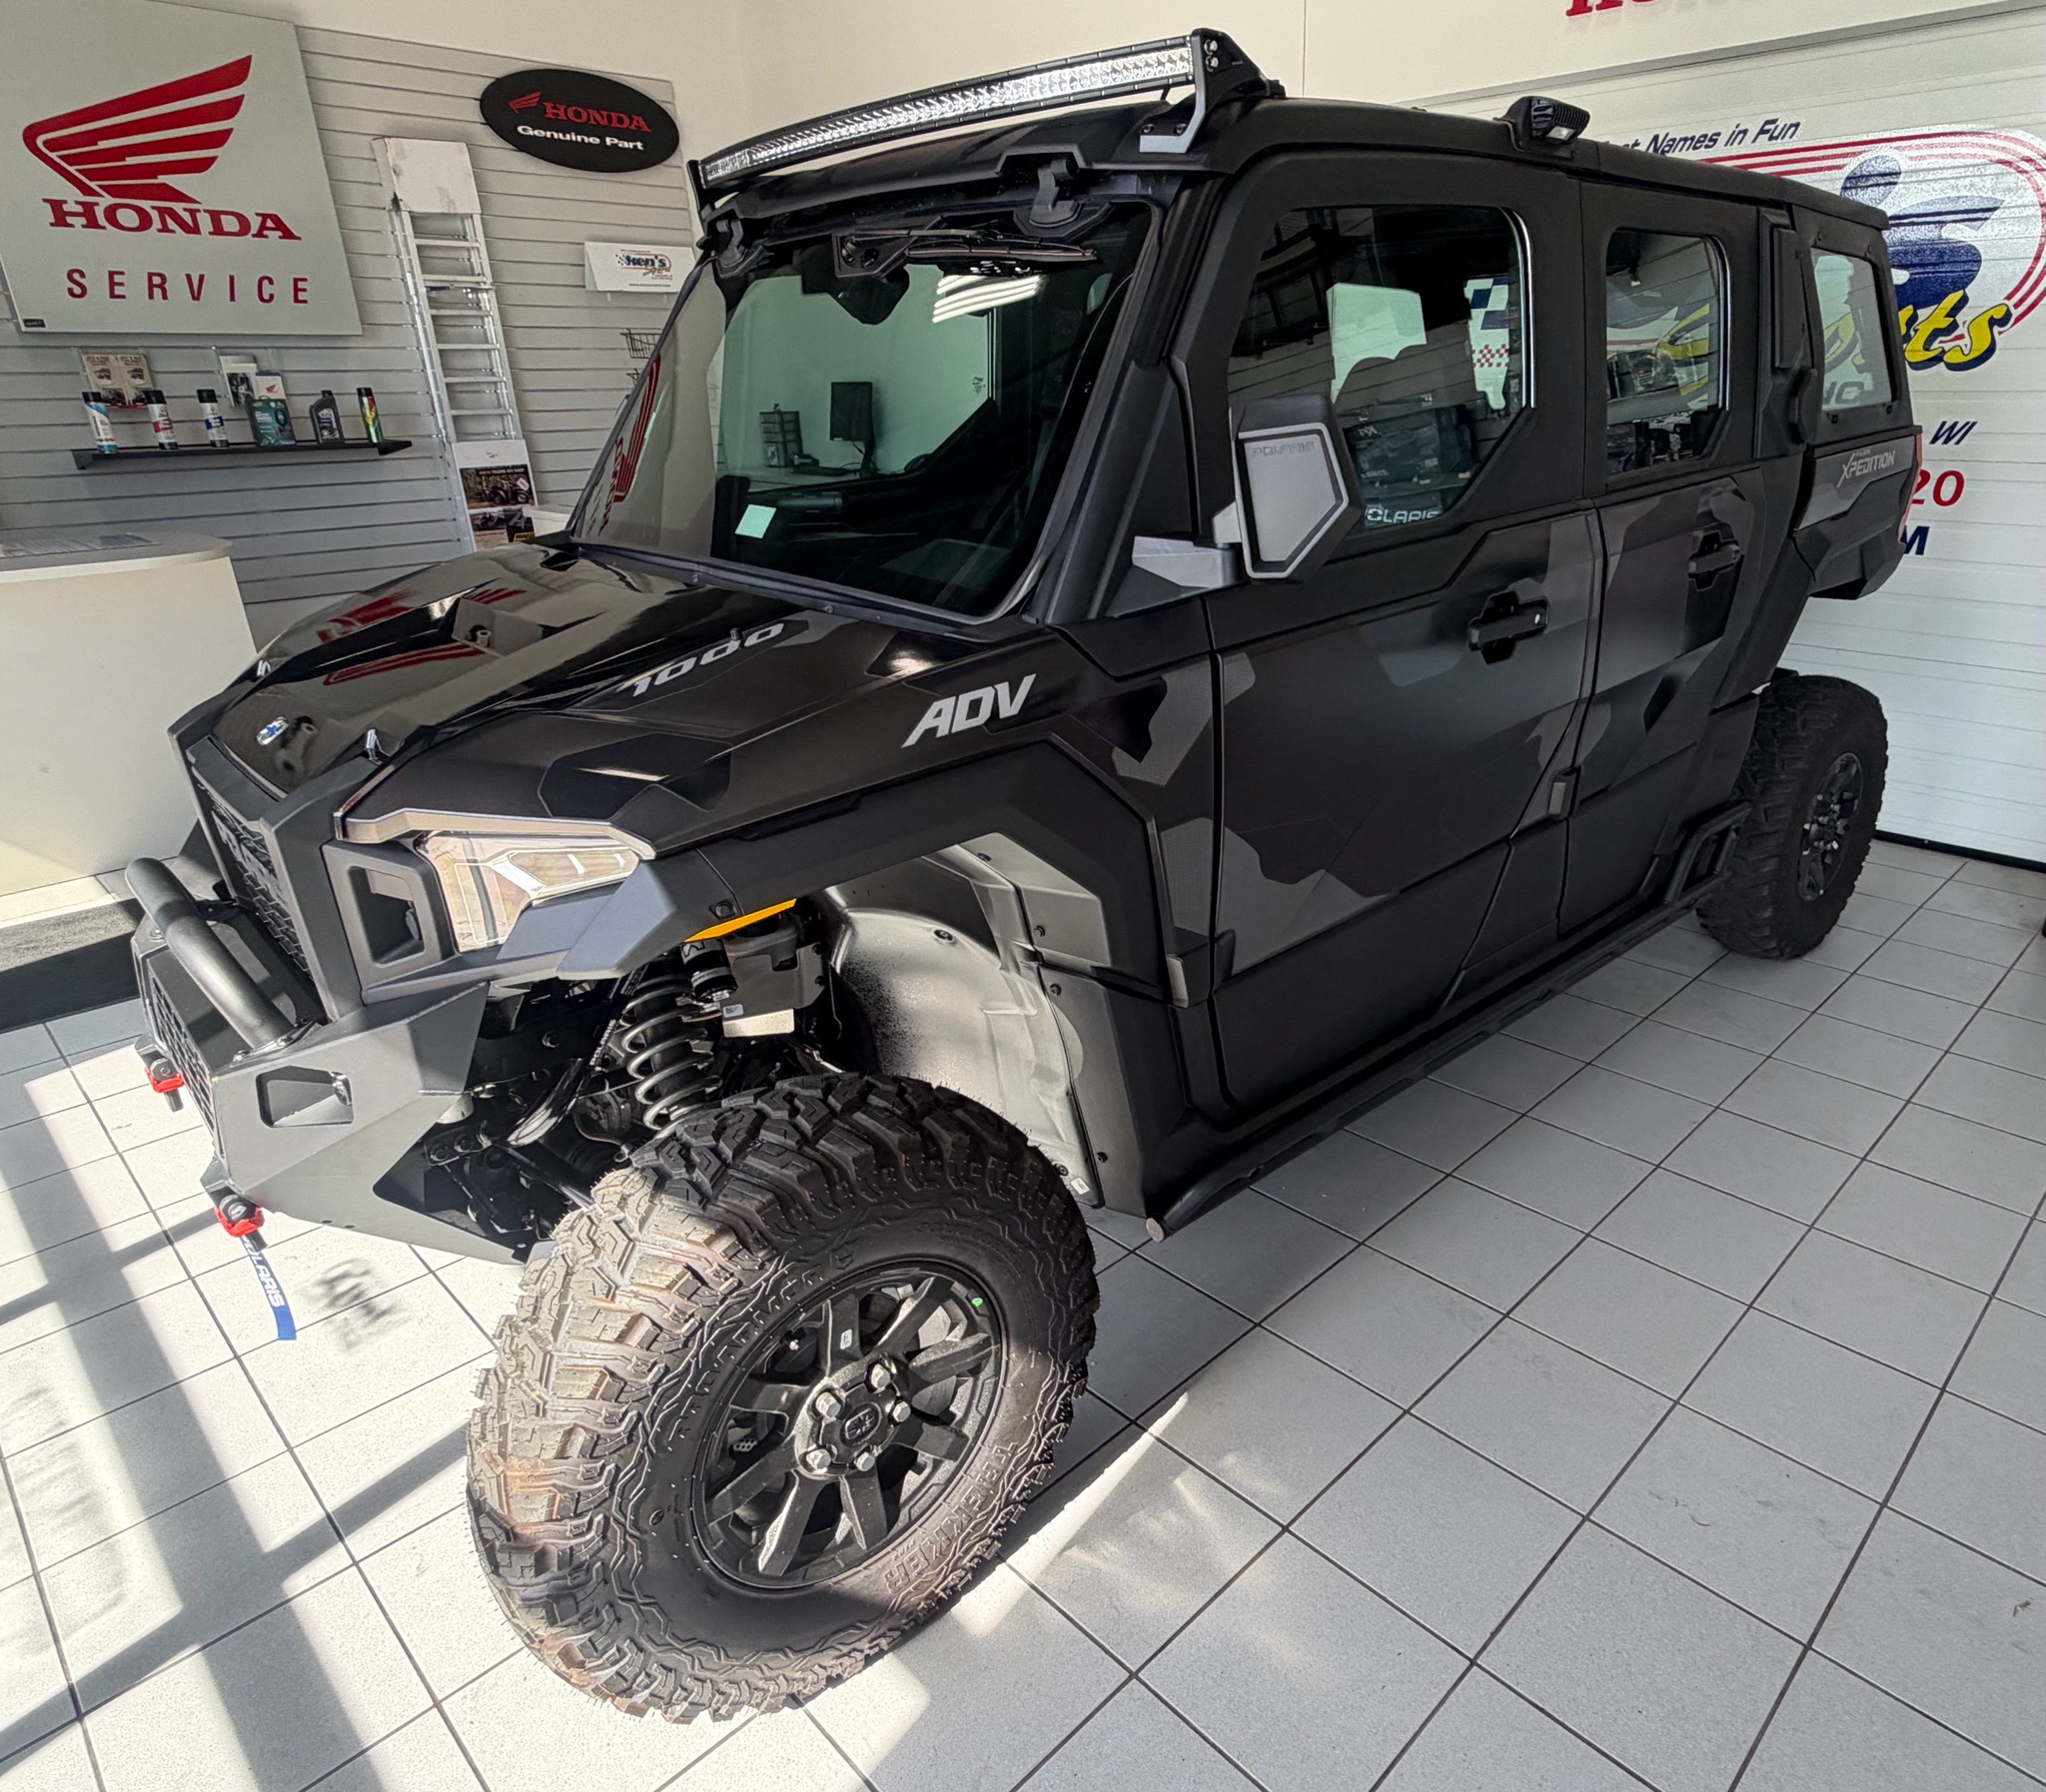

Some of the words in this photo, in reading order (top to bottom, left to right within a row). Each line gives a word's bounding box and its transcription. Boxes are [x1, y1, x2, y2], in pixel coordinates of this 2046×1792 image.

[542, 102, 651, 132] HONDA
[516, 125, 600, 144] Genuine
[605, 136, 644, 150] Part
[1647, 133, 1721, 156] Names
[1724, 123, 1748, 147] in
[1751, 118, 1801, 143] Fun
[42, 198, 303, 241] HONDA
[66, 268, 309, 305] SERVICE
[1929, 421, 1978, 446] WI
[1836, 449, 1896, 488] XPEDITION
[902, 674, 1037, 748] ADV
[589, 1019, 616, 1066] POLARIS
